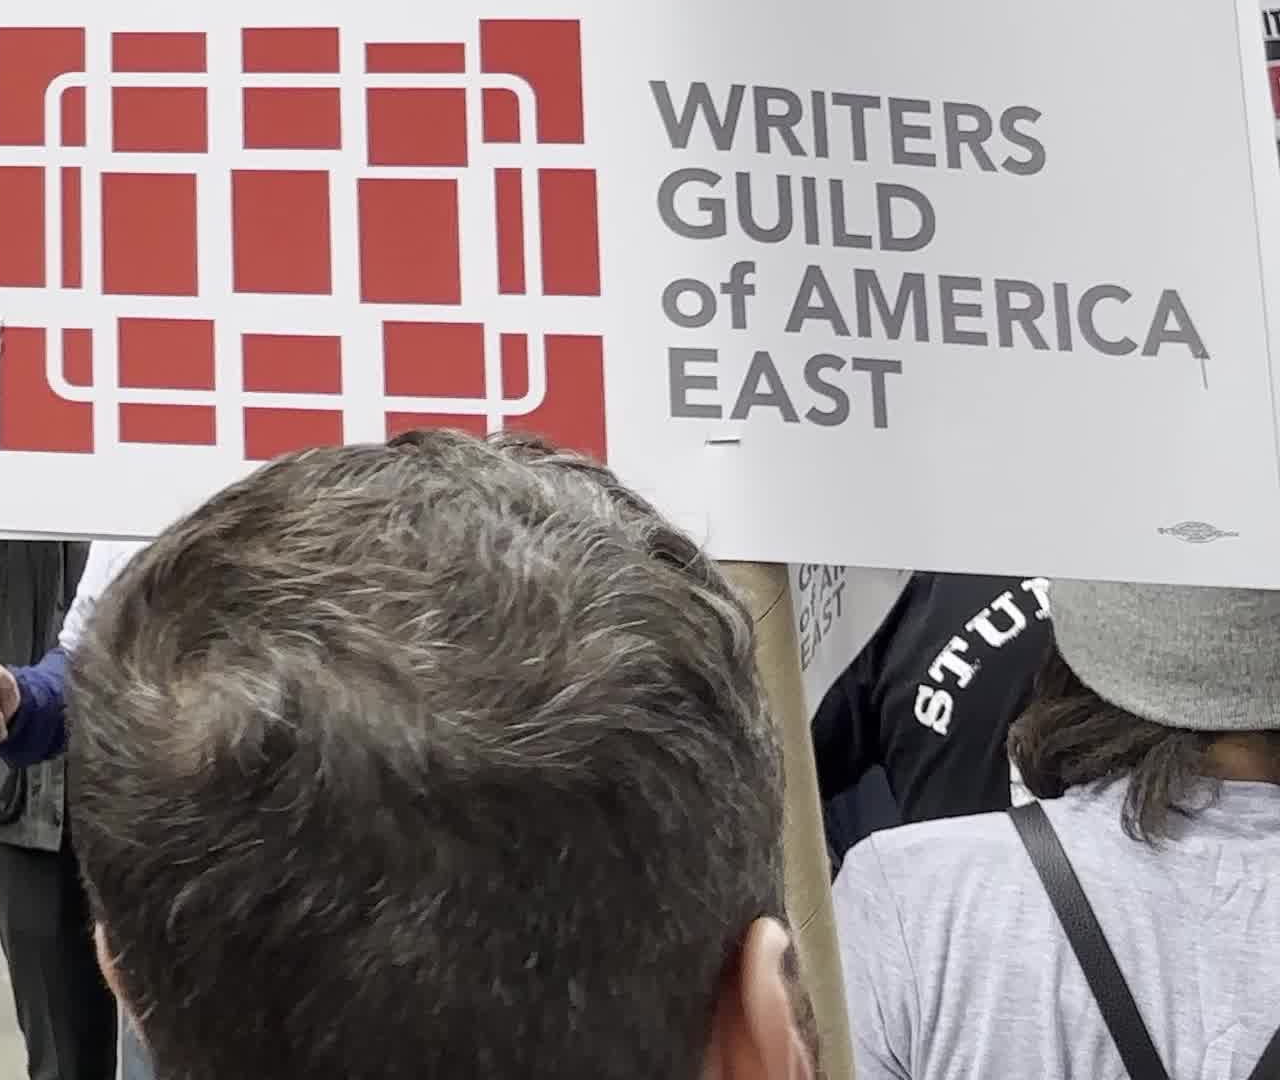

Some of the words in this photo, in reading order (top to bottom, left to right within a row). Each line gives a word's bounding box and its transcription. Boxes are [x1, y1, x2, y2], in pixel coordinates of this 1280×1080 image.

[647, 79, 1046, 177] WRITERS
[656, 166, 936, 253] GUILD
[661, 260, 756, 329] of
[783, 264, 1211, 359] AMERICA
[667, 346, 903, 429] EAST
